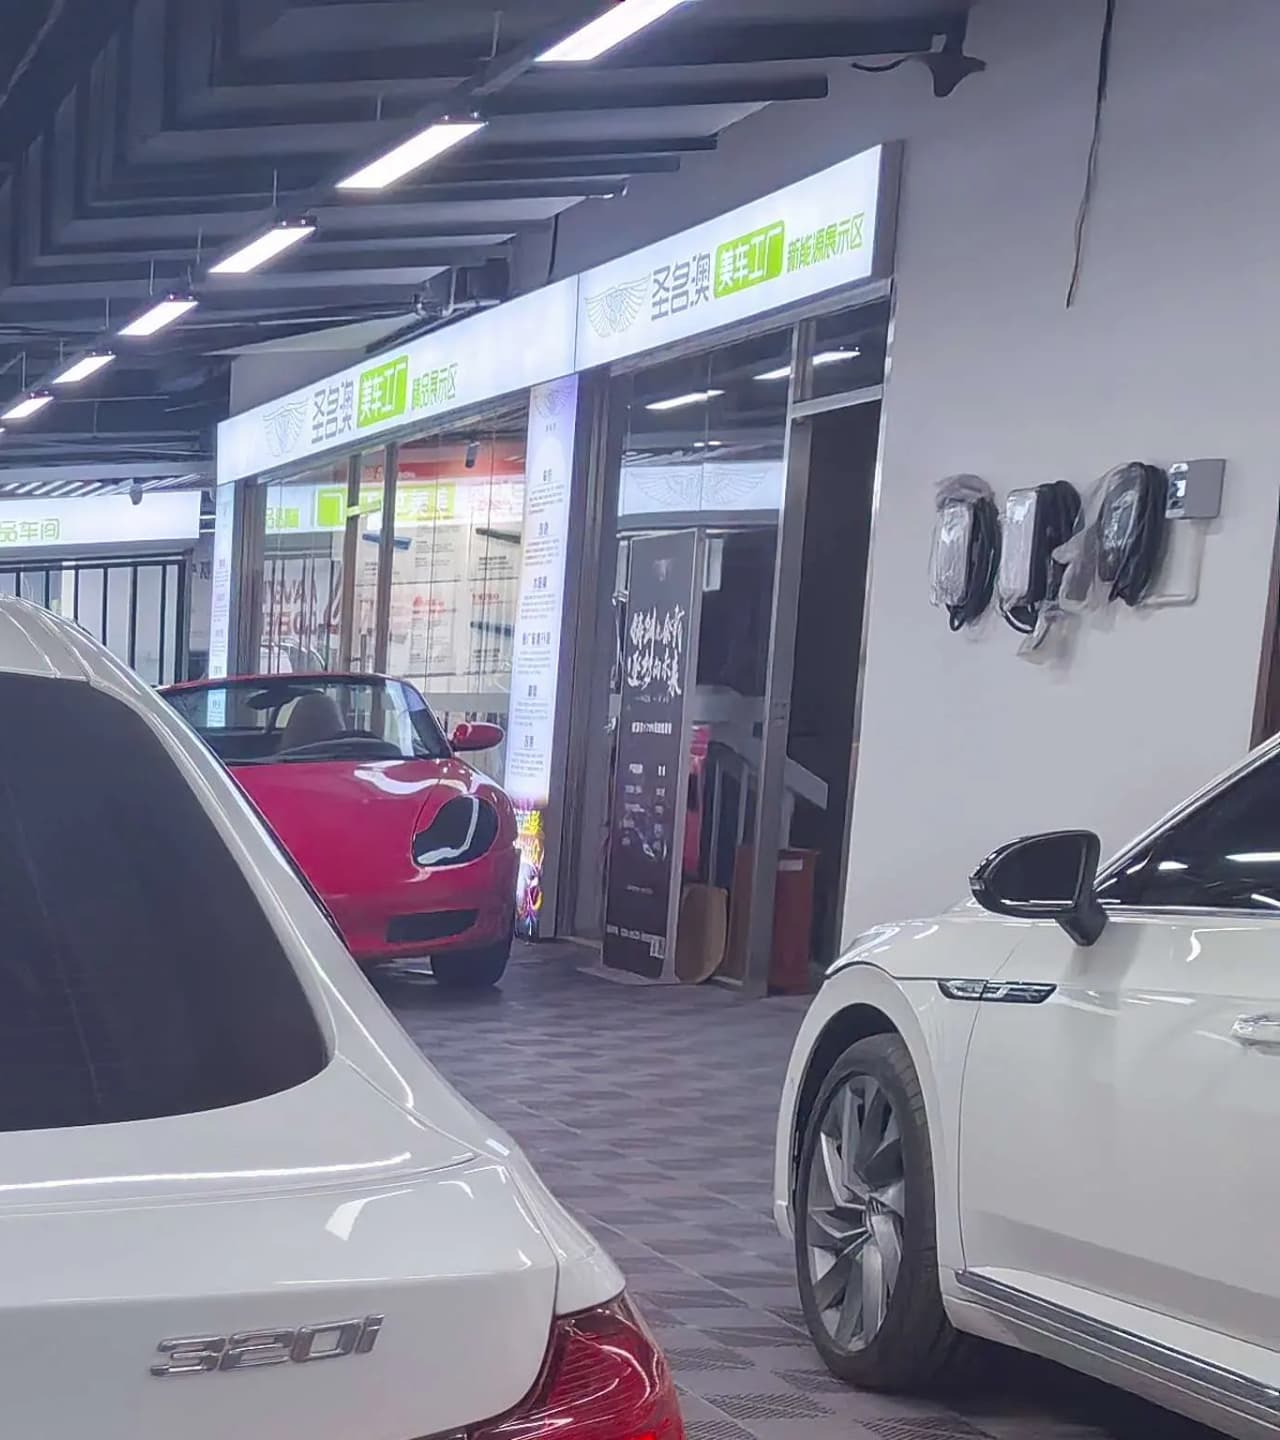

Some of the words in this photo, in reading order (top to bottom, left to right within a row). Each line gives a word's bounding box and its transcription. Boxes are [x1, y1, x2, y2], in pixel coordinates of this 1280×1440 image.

[650, 253, 711, 321] 圣名澳
[718, 226, 782, 292] 美车工厂
[786, 212, 865, 274] 新能源展示区
[359, 361, 407, 422] 美车工厂
[150, 1312, 385, 1377] 320i
